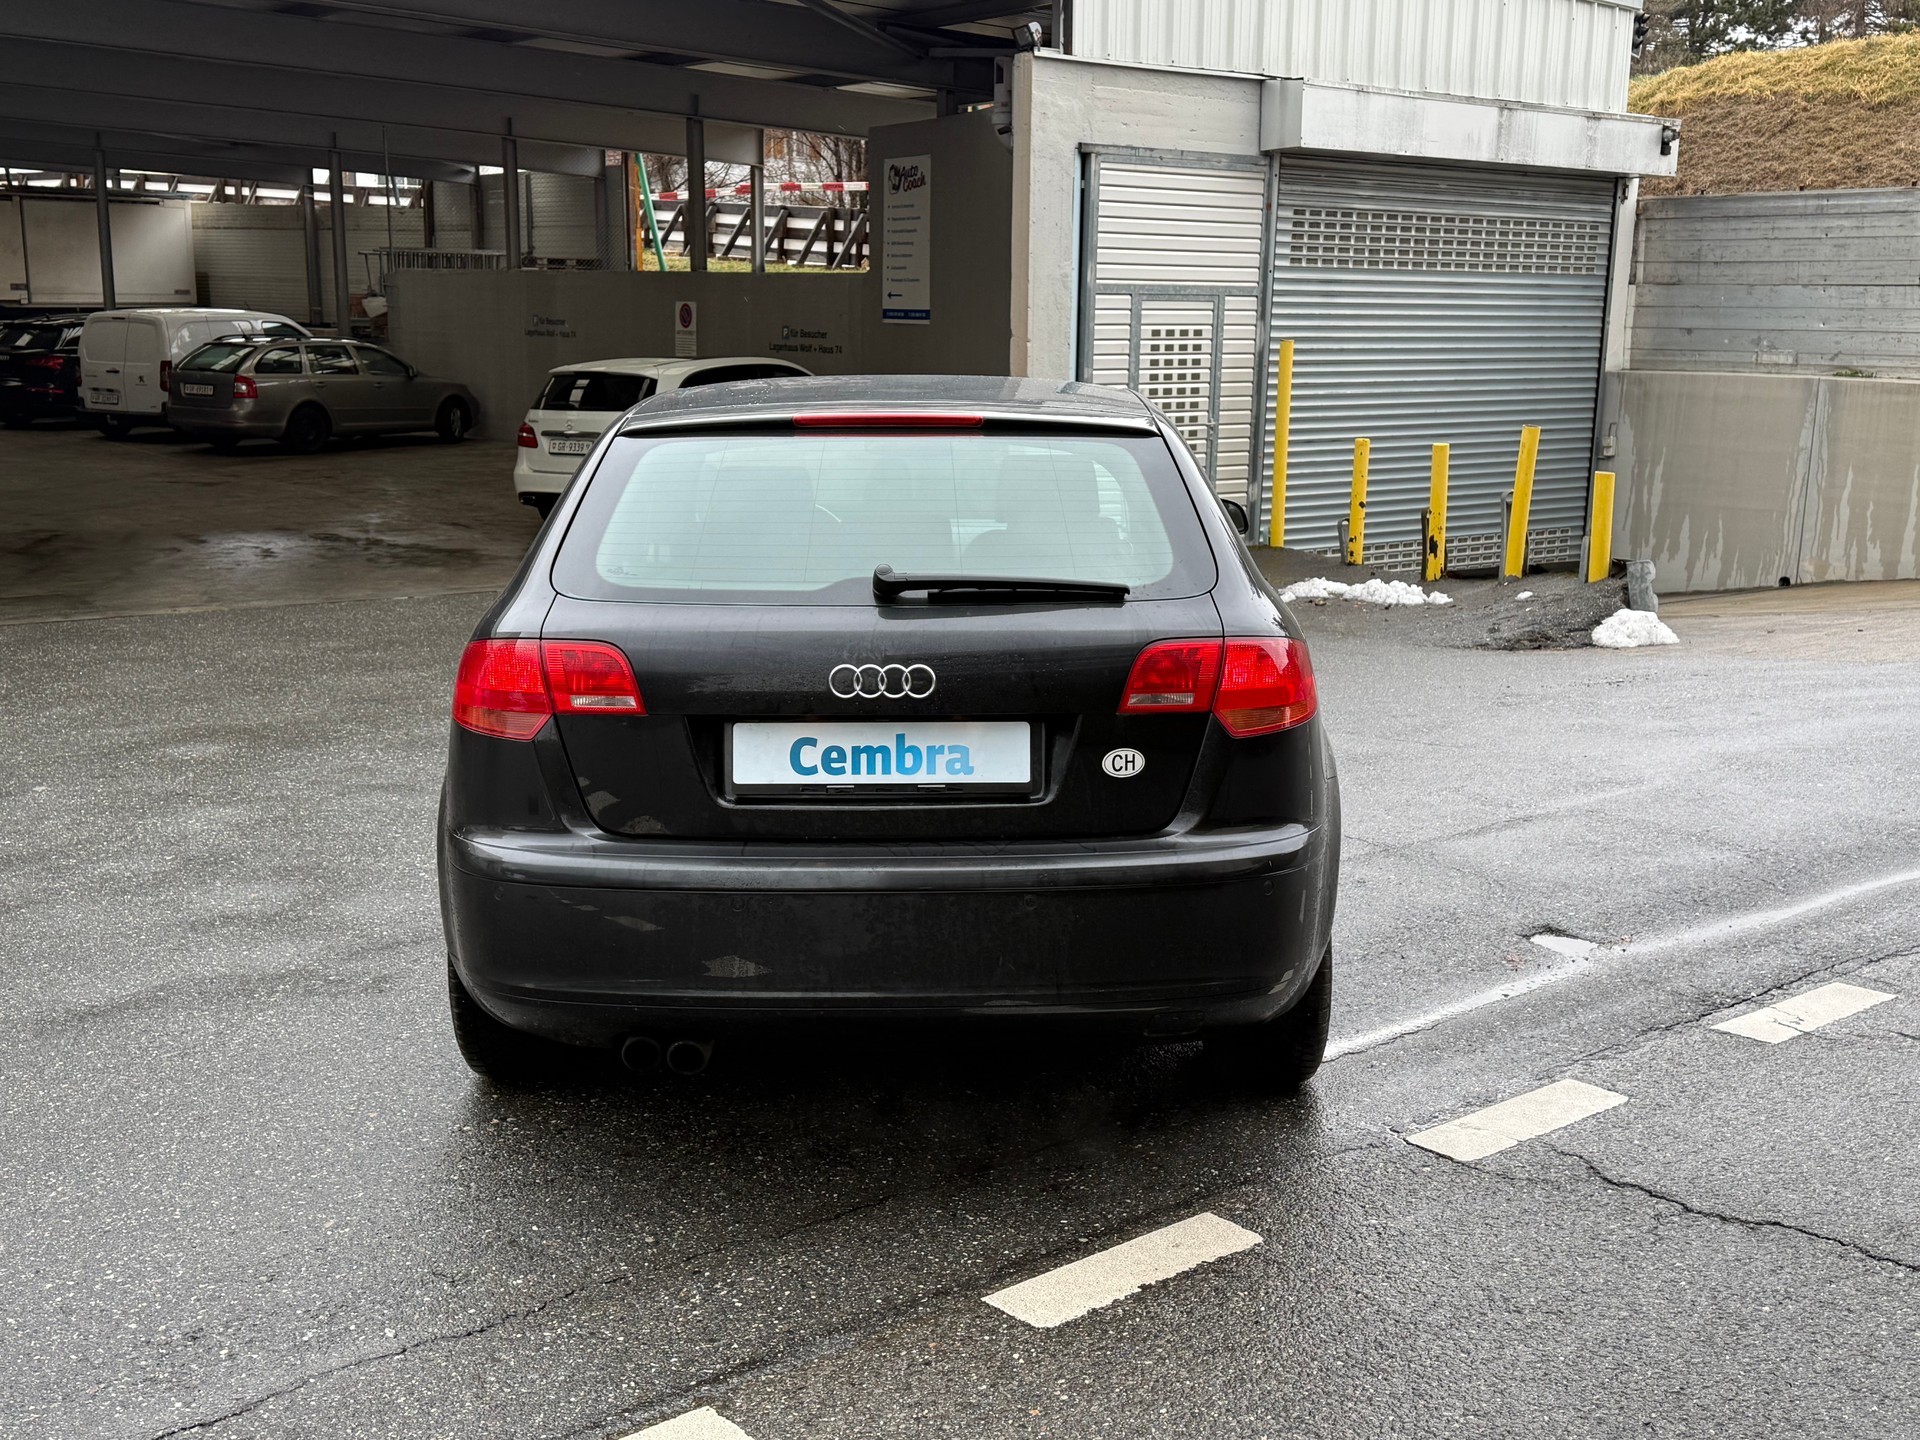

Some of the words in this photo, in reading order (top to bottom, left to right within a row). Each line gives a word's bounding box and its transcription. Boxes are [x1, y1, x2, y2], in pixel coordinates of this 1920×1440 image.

[903, 171, 926, 192] Coach
[800, 328, 828, 339] Besucher
[769, 342, 799, 353] Lagerhaus
[800, 343, 813, 353] Wolf
[818, 344, 834, 354] Haus
[835, 345, 843, 354] 74
[789, 733, 974, 776] Cembra
[1111, 754, 1136, 773] CH
